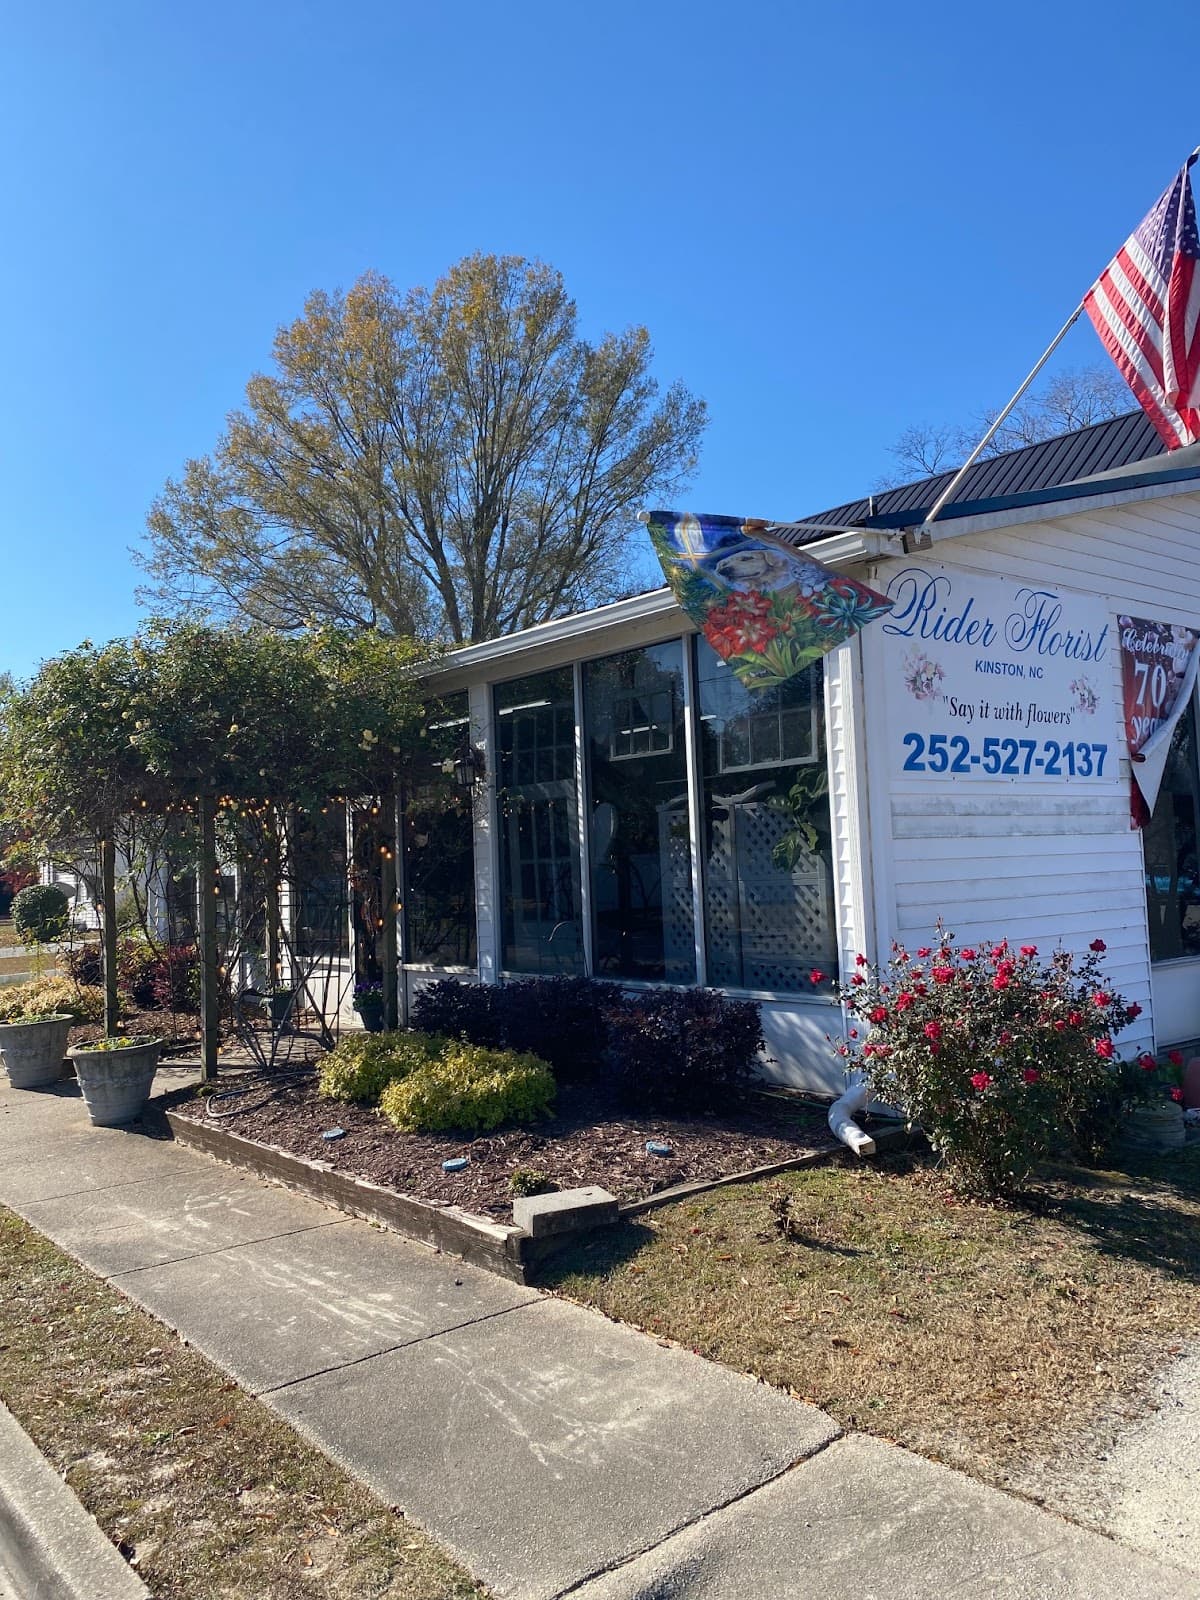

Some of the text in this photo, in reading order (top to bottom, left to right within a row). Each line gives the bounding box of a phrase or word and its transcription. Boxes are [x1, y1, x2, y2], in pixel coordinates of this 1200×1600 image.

[882, 567, 1109, 662] Rider Florist
[975, 660, 1044, 679] KINSTON, NC
[1134, 661, 1168, 707] 70
[979, 700, 990, 719] it
[993, 701, 1022, 721] with
[902, 732, 1108, 777] 252-527-2137
